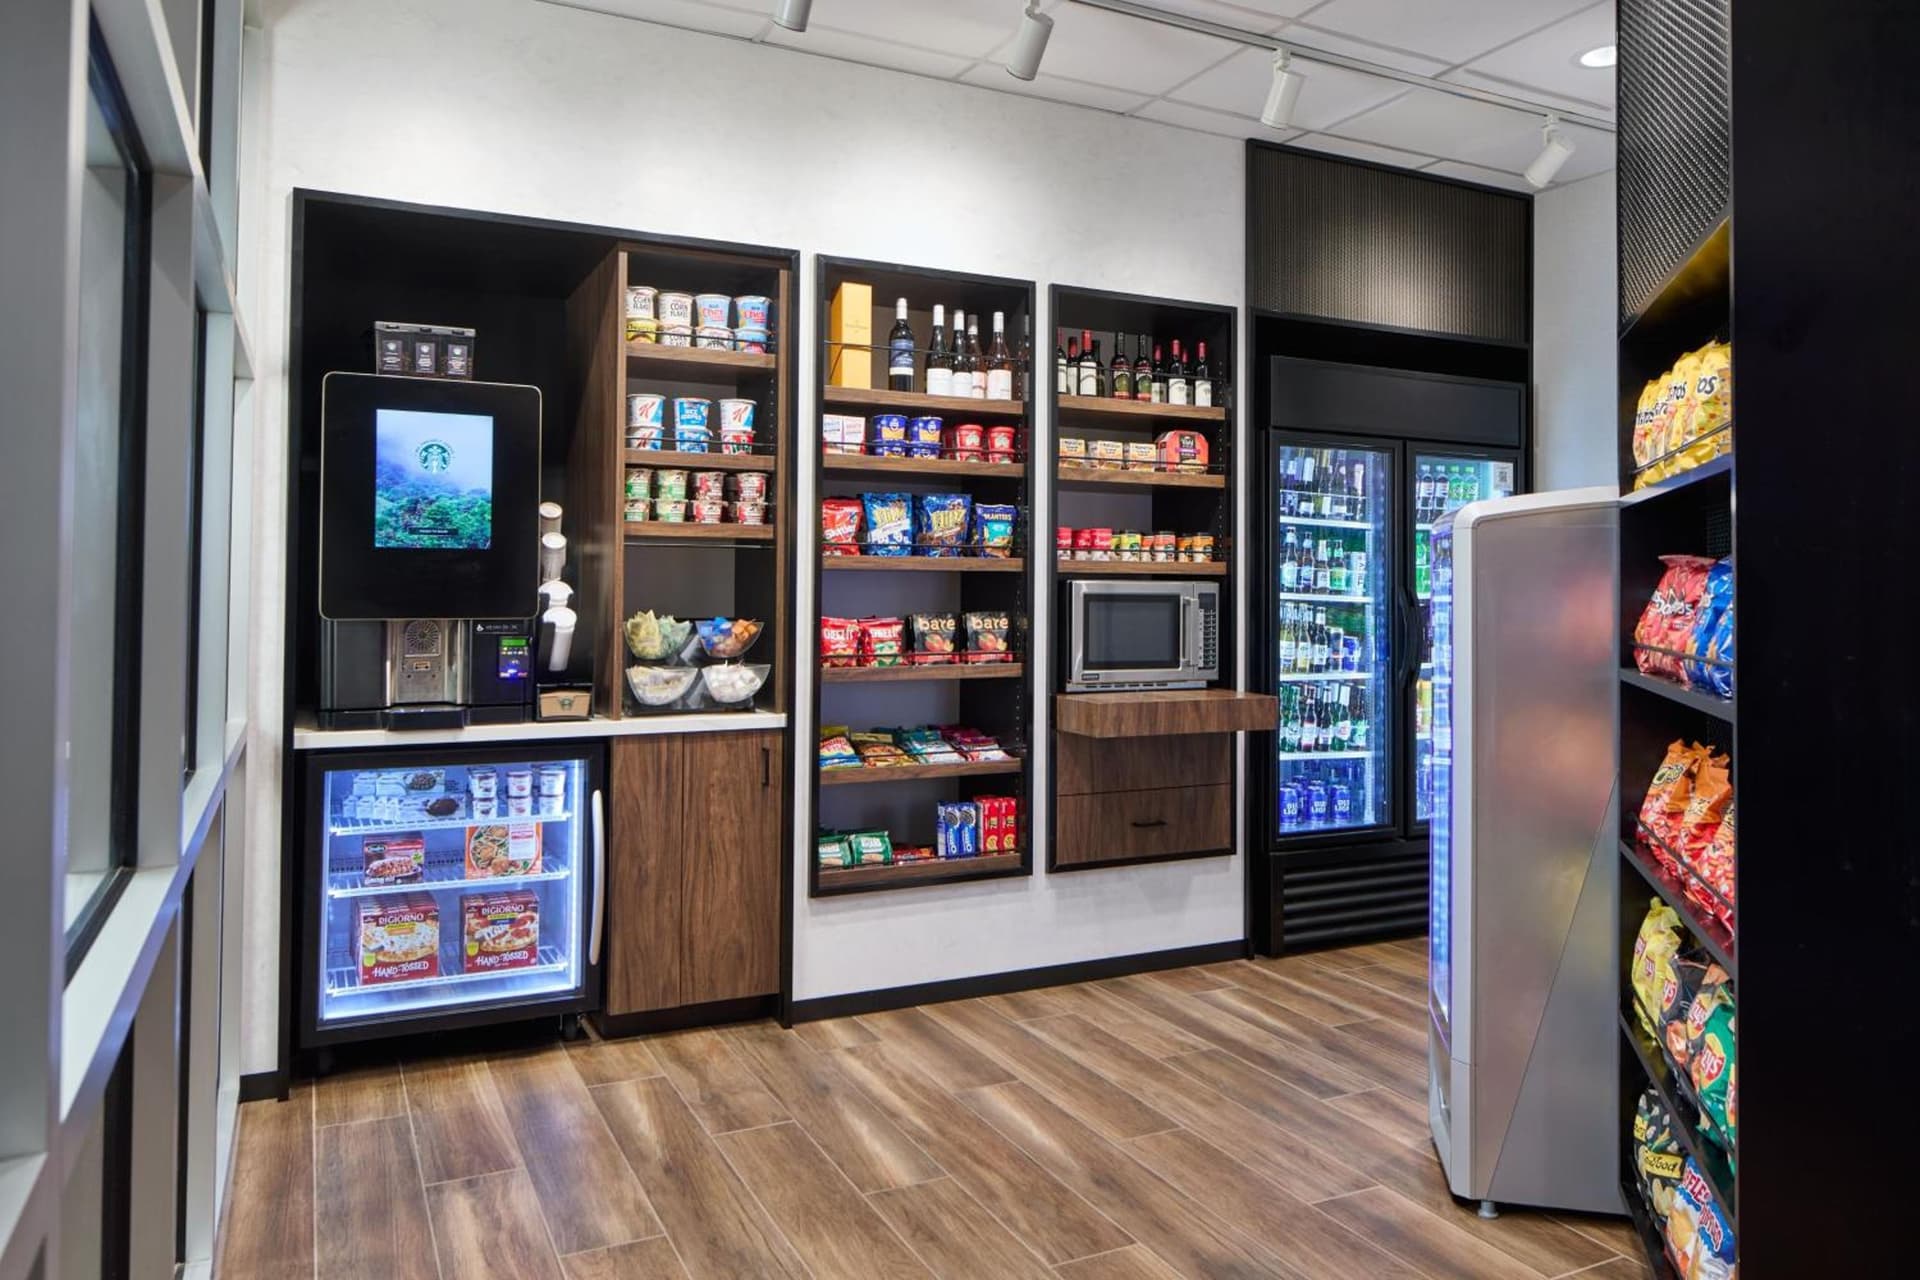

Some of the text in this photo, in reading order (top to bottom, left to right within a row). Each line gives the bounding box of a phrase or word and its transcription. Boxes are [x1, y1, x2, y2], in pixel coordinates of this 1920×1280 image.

[670, 302, 688, 311] CORN
[918, 616, 956, 631] bare
[971, 615, 1008, 629] bare
